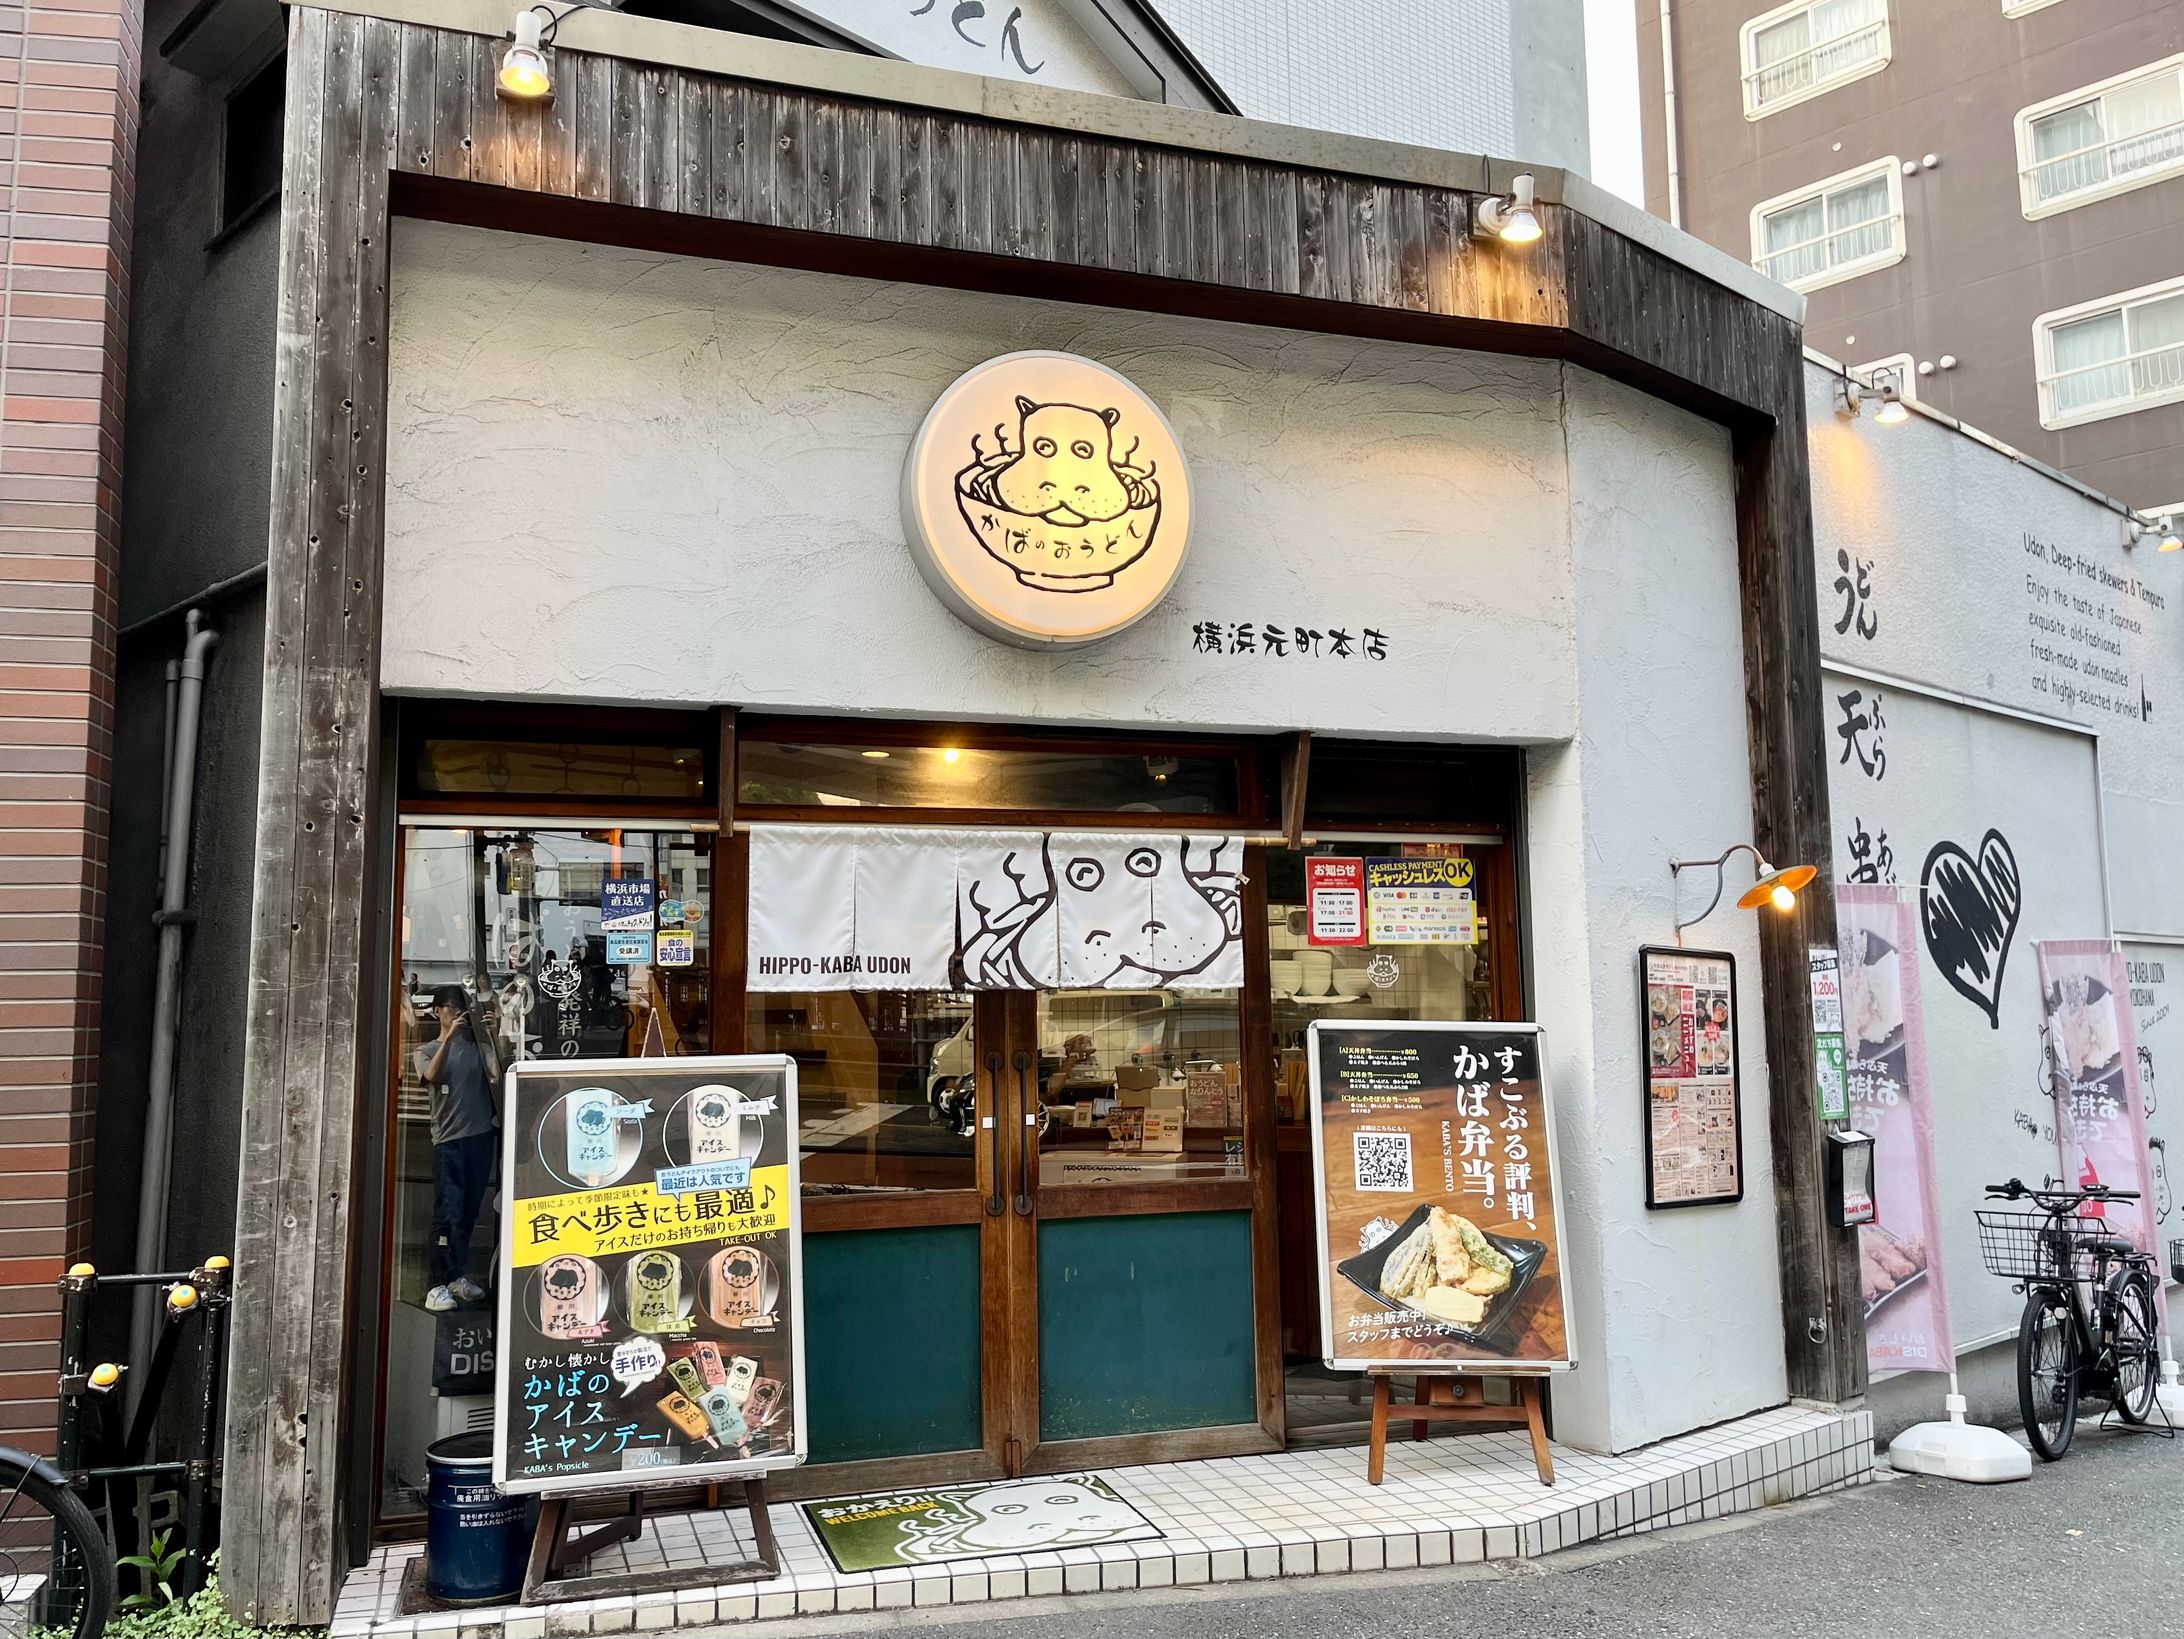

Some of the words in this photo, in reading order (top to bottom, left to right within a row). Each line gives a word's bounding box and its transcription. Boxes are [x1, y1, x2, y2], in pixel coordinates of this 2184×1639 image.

[980, 512, 1143, 560] かばのおうどん
[2023, 532, 2049, 564] Udon,
[2051, 544, 2097, 581] Deep-fried
[2099, 569, 2128, 594] skewers
[2130, 578, 2136, 596] &
[2137, 581, 2166, 610] Tempura
[2026, 574, 2050, 605] Enjoy
[2054, 586, 2069, 607] the
[2073, 595, 2094, 617] taste
[2097, 604, 2105, 623] of
[2110, 607, 2143, 635] Japanese
[1193, 621, 1390, 660] 横浜元町本店
[2028, 612, 2066, 636] exquisite
[2070, 623, 2121, 656] old-fashioned
[2030, 638, 2079, 671] fresh-made
[2082, 659, 2100, 677] udon
[2101, 667, 2129, 688] noodles
[2032, 673, 2048, 692] and
[2052, 675, 2111, 711] highly-selected
[2114, 697, 2140, 719] drinks!
[1314, 864, 1356, 877] お知らせ
[1368, 862, 1407, 872] CASHLESS
[1408, 861, 1444, 870] PAYMENT
[1444, 861, 1471, 879] OK
[1369, 868, 1446, 887] キャッシュレス
[605, 883, 651, 895] 横浜市場
[611, 895, 645, 907] 直送店
[618, 947, 640, 955] 受講済
[668, 939, 683, 947] 食の
[659, 947, 691, 961] 安心宣言
[759, 955, 863, 975] HIPPO-KABA
[867, 956, 911, 974] UDON
[2150, 963, 2166, 984] UDON
[1812, 981, 1838, 996] 1,200円
[1190, 1079, 1218, 1087] おうどん
[1190, 1087, 1224, 1096] かりんとう
[1453, 1044, 1496, 1209] かば弁当。
[1442, 1120, 1453, 1156] KABA'S
[1494, 1045, 1537, 1231] すこぶる評判、
[661, 1171, 746, 1191] 最近は人気です
[1444, 1159, 1455, 1192] BENTO
[594, 1214, 776, 1253] アイスだけのお持ち帰りも大歓迎
[719, 1232, 761, 1247] TAKE-OUT
[764, 1231, 777, 1240] OK
[639, 1309, 674, 1318] キャンデー
[642, 1302, 665, 1310] アイス
[724, 1307, 759, 1316] キャンデー
[727, 1300, 751, 1308] アイス
[547, 1320, 587, 1332] キャンデー
[551, 1313, 577, 1322] アイス
[1348, 1309, 1427, 1328] お弁当販売中!
[524, 1352, 610, 1371] むかし懐かし
[524, 1369, 610, 1400] かばの
[525, 1400, 605, 1430] アイス
[524, 1423, 662, 1460] キャンデー
[524, 1464, 553, 1474] KABA's
[556, 1461, 590, 1472] Popsicle
[824, 1508, 899, 1526] WELCOME
[900, 1501, 940, 1514] BACK
